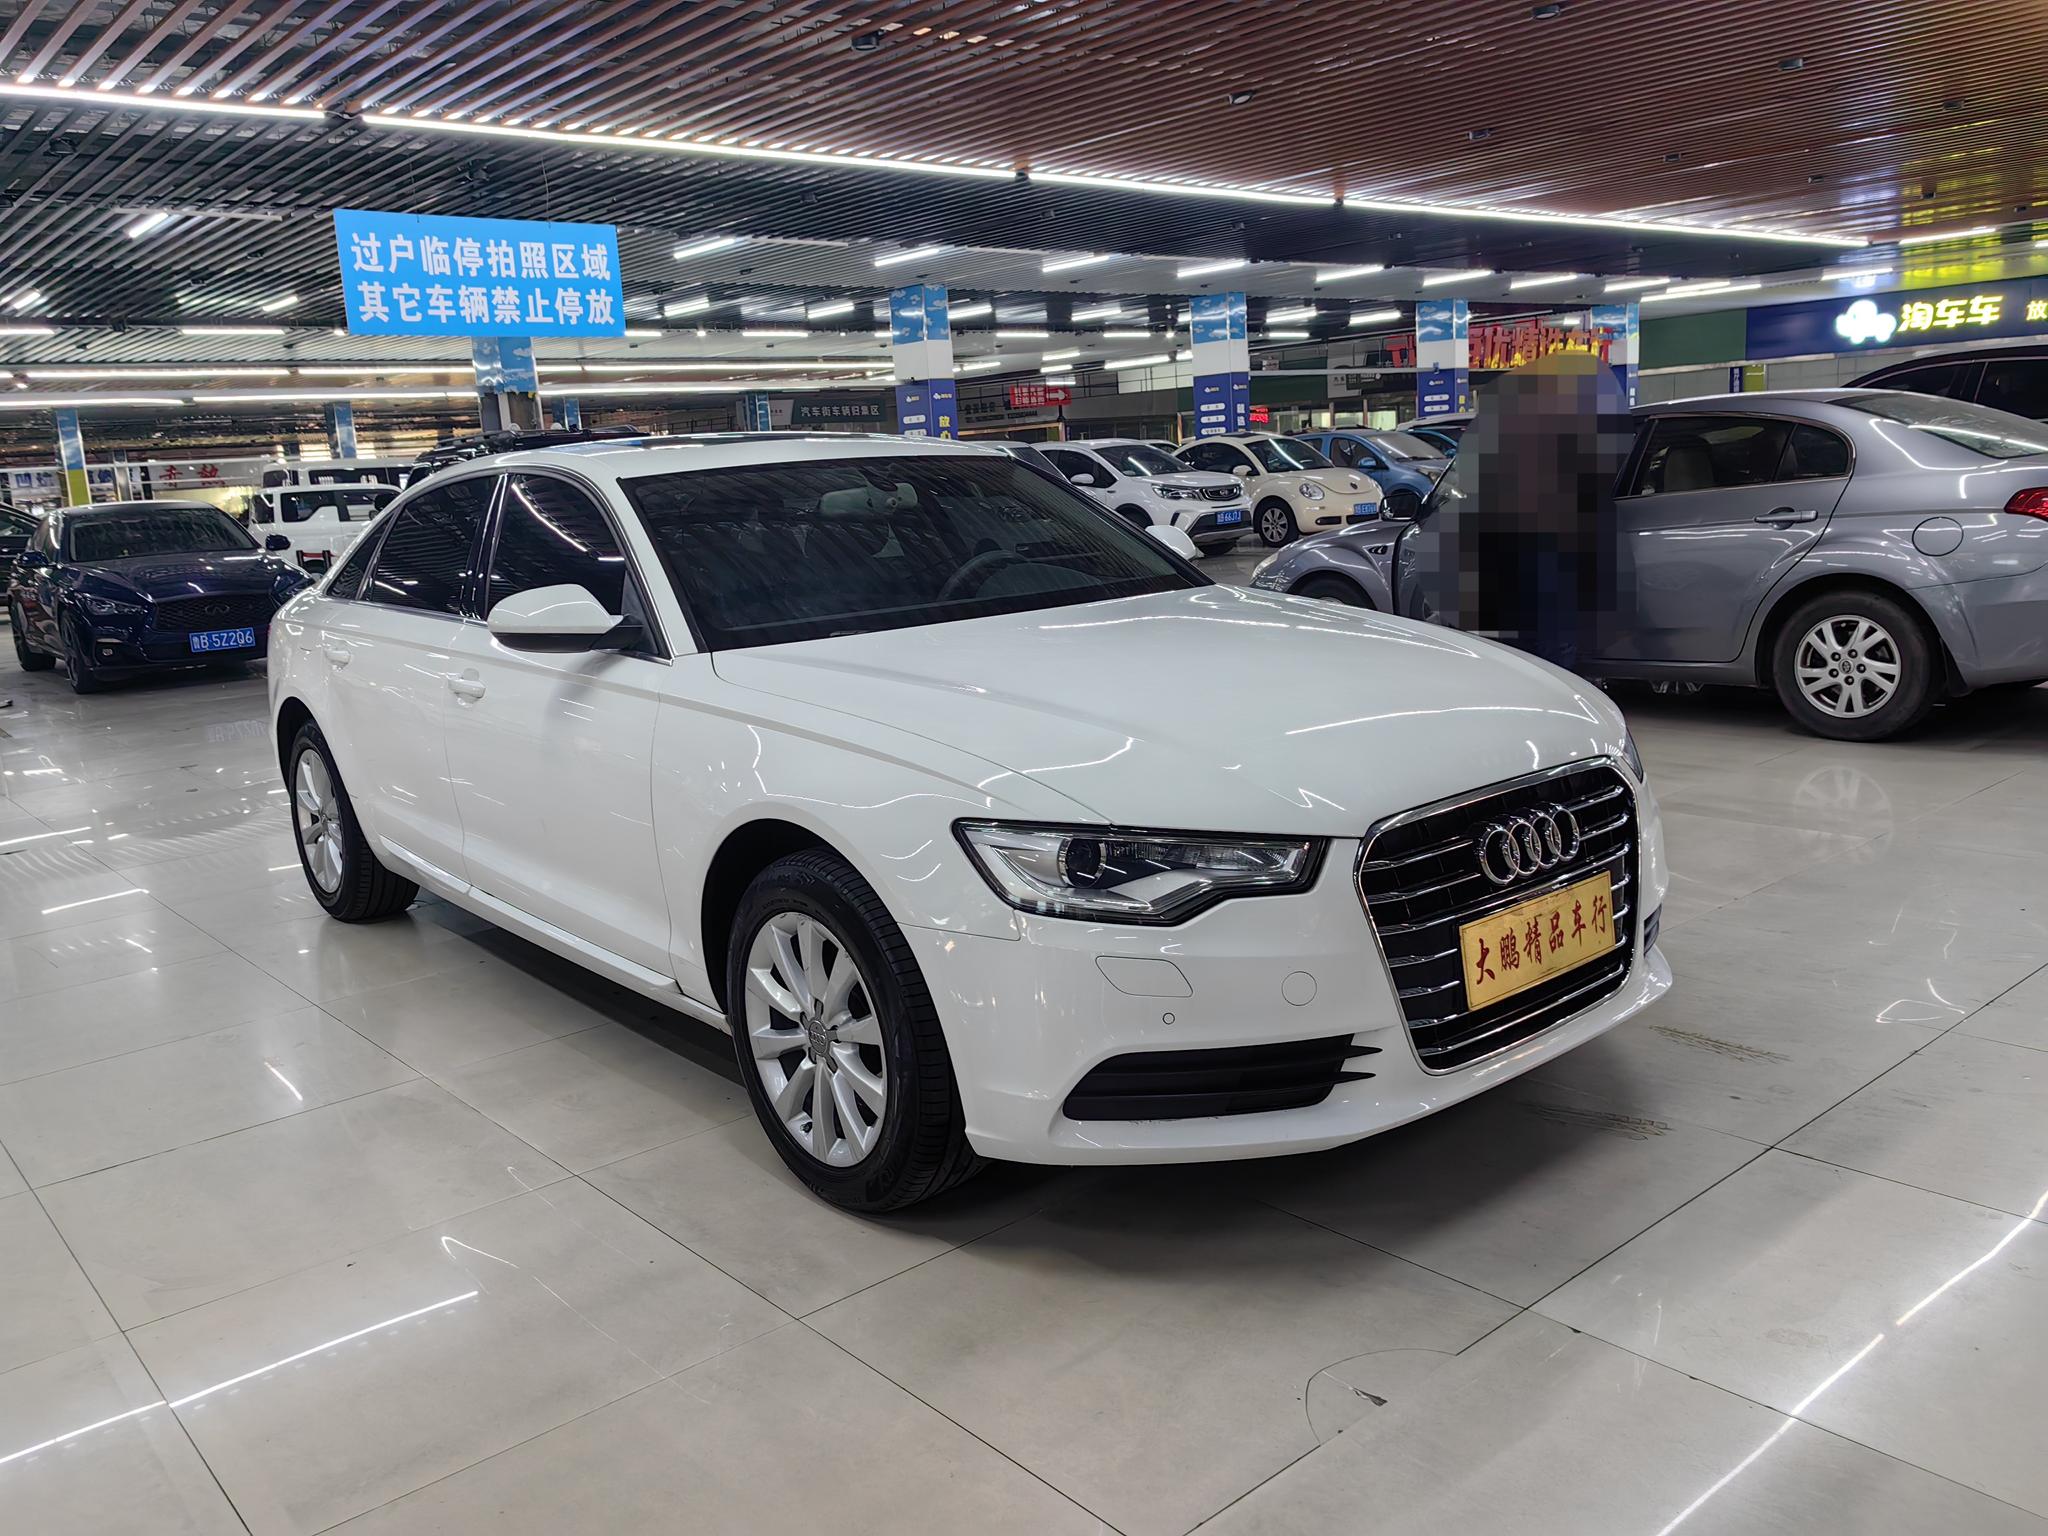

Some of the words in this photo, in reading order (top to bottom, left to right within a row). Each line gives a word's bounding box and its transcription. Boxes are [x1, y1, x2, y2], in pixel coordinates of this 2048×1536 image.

[350, 232, 611, 281] 过户临停拍照区域
[357, 281, 616, 325] 其它车辆禁止停放
[1898, 295, 2004, 332] 淘车车
[1476, 895, 1607, 985] 大鹏精品车行
